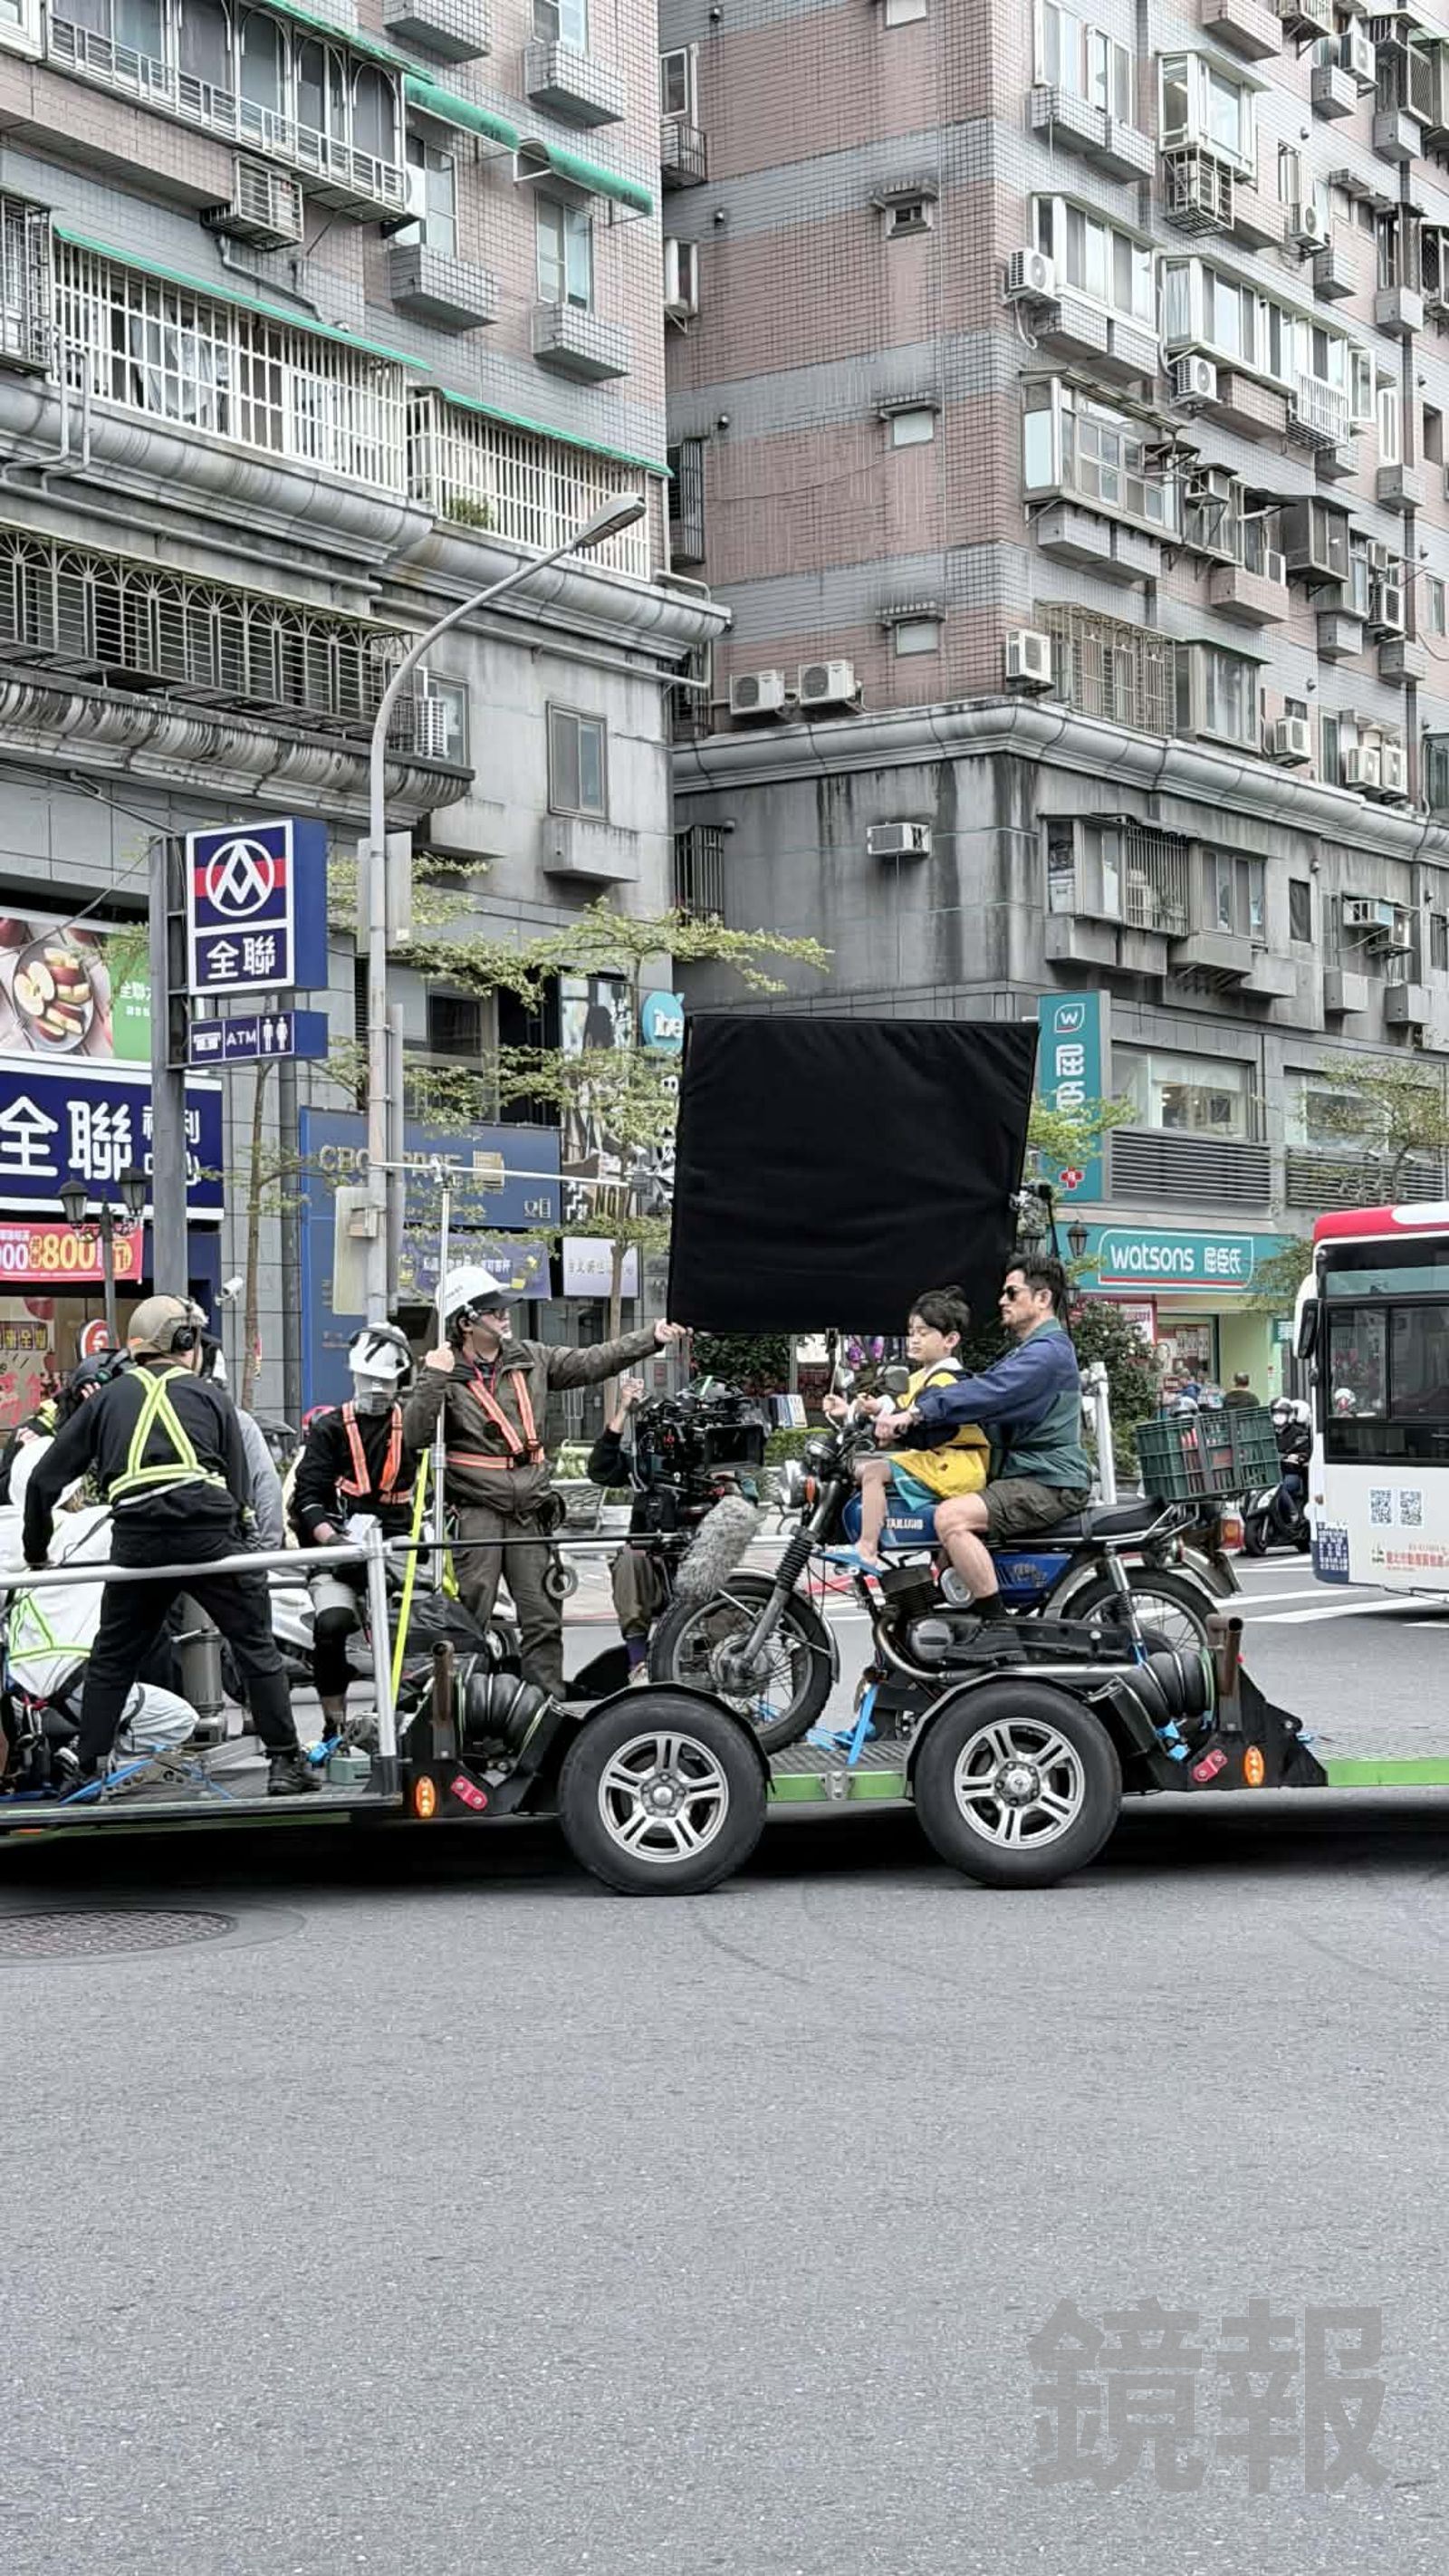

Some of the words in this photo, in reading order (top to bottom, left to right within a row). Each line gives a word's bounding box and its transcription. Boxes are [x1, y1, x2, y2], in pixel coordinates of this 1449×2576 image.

[206, 935, 275, 979] 全聯
[226, 1029, 256, 1046] ATM
[1056, 1043, 1086, 1139] 屈臣
[0, 1095, 132, 1181] 全聯
[42, 1234, 96, 1270] 800
[1110, 1241, 1195, 1273] watsons
[1204, 1246, 1243, 1274] 屈臣氏
